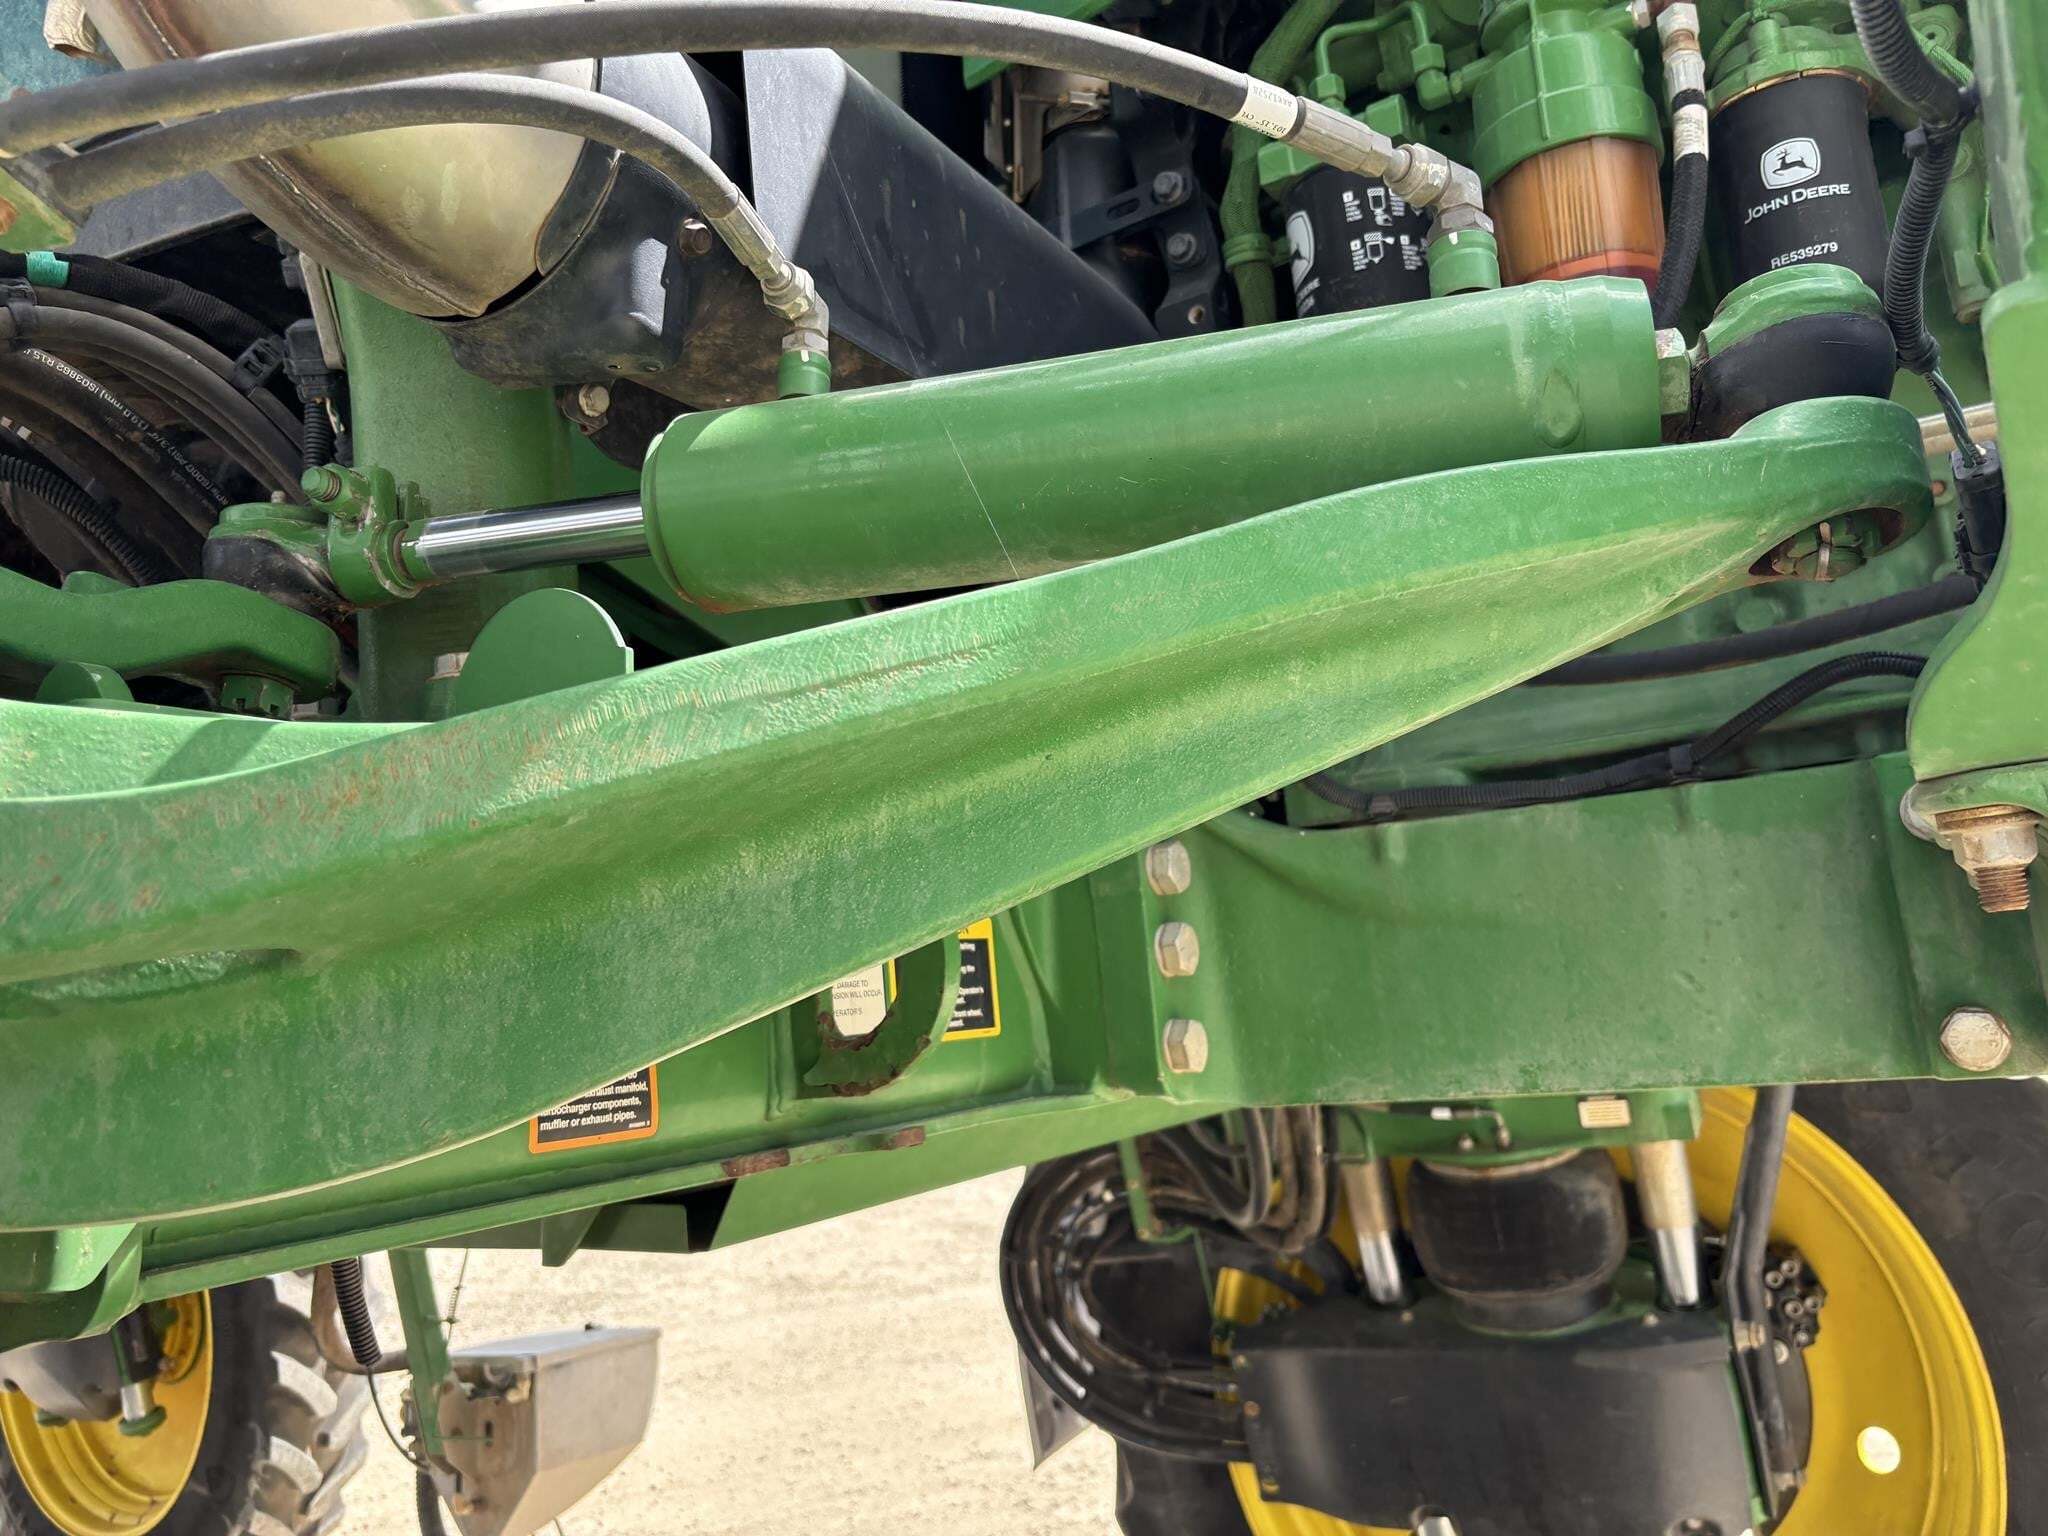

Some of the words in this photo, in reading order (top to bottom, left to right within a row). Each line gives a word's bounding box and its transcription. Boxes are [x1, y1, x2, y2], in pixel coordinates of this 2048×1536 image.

[1744, 195, 1789, 225] JOHN
[1791, 183, 1851, 203] DEERE
[1771, 241, 1839, 269] RE539279
[33, 350, 54, 367] R15
[56, 362, 100, 394] ISO3862
[861, 979, 869, 987] TO
[833, 991, 849, 1000] SION
[850, 989, 863, 999] WILL
[615, 1081, 649, 1095] manifold,
[592, 1096, 642, 1113] components,
[540, 1116, 570, 1131] muffler
[571, 1117, 581, 1127] or
[581, 1111, 613, 1126] exhaust
[613, 1110, 637, 1123] pipes.
